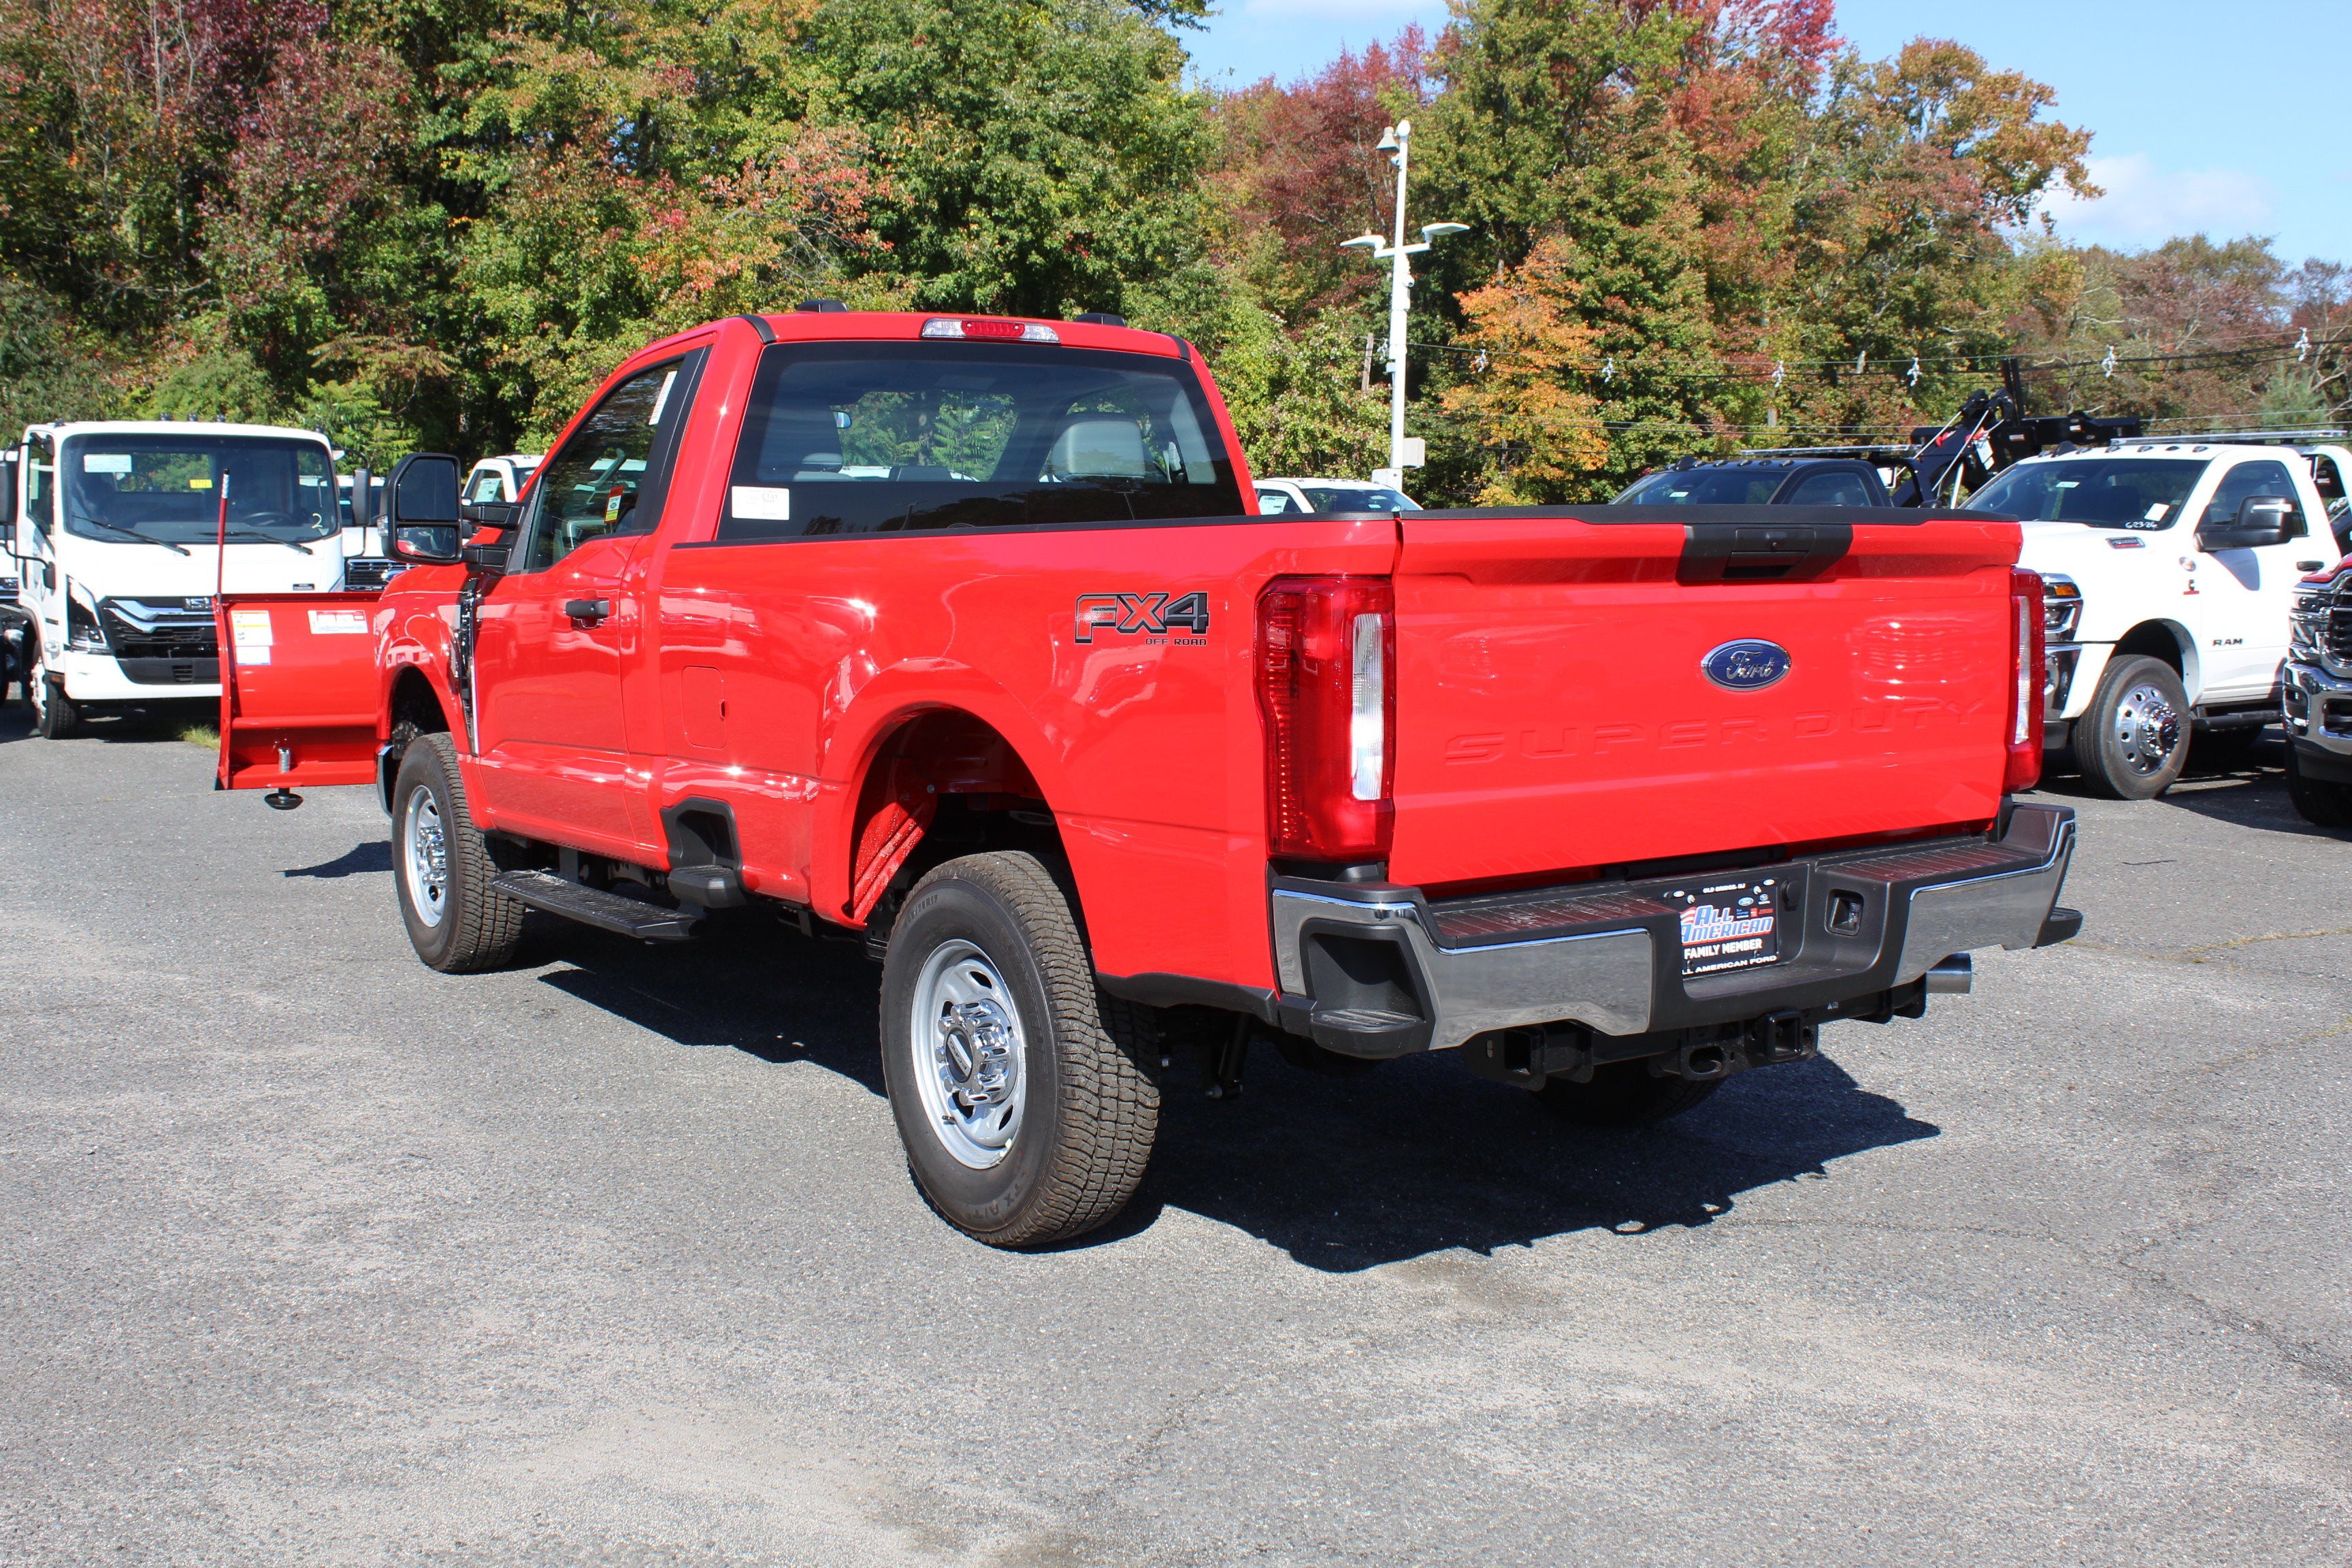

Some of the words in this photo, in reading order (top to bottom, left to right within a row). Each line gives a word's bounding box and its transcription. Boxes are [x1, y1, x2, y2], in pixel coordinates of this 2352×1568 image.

[312, 513, 323, 529] 2
[1075, 591, 1209, 644] FX4
[2212, 638, 2243, 647] RAM
[1727, 651, 1774, 679] Ford
[1444, 715, 1768, 766] SUPER
[1793, 698, 1983, 738] DUTY
[1684, 944, 1720, 960] FAMILY
[1722, 938, 1763, 954] MEMBER
[1695, 960, 1748, 973] AMERICAN
[1750, 955, 1778, 965] FORD
